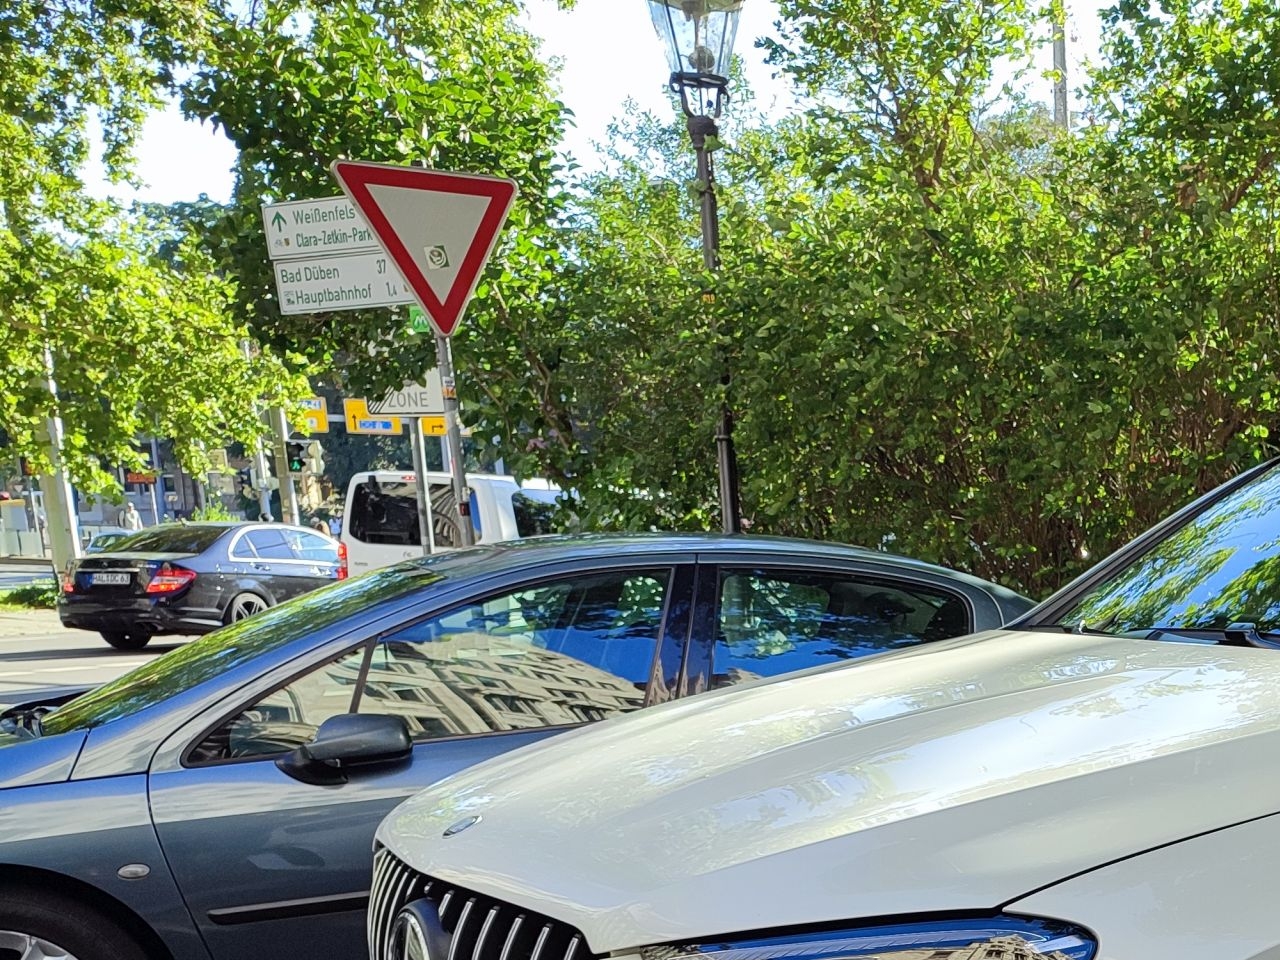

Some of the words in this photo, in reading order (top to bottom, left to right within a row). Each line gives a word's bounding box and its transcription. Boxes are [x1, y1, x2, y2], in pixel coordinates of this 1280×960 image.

[292, 205, 356, 225] Weißenfels
[296, 227, 373, 247] Clara-Zetkin-Park
[281, 266, 301, 284] Bad
[304, 265, 340, 281] Düben
[376, 259, 386, 274] 37
[295, 284, 372, 306] Hauptbahnhof
[388, 392, 429, 408] ZONE
